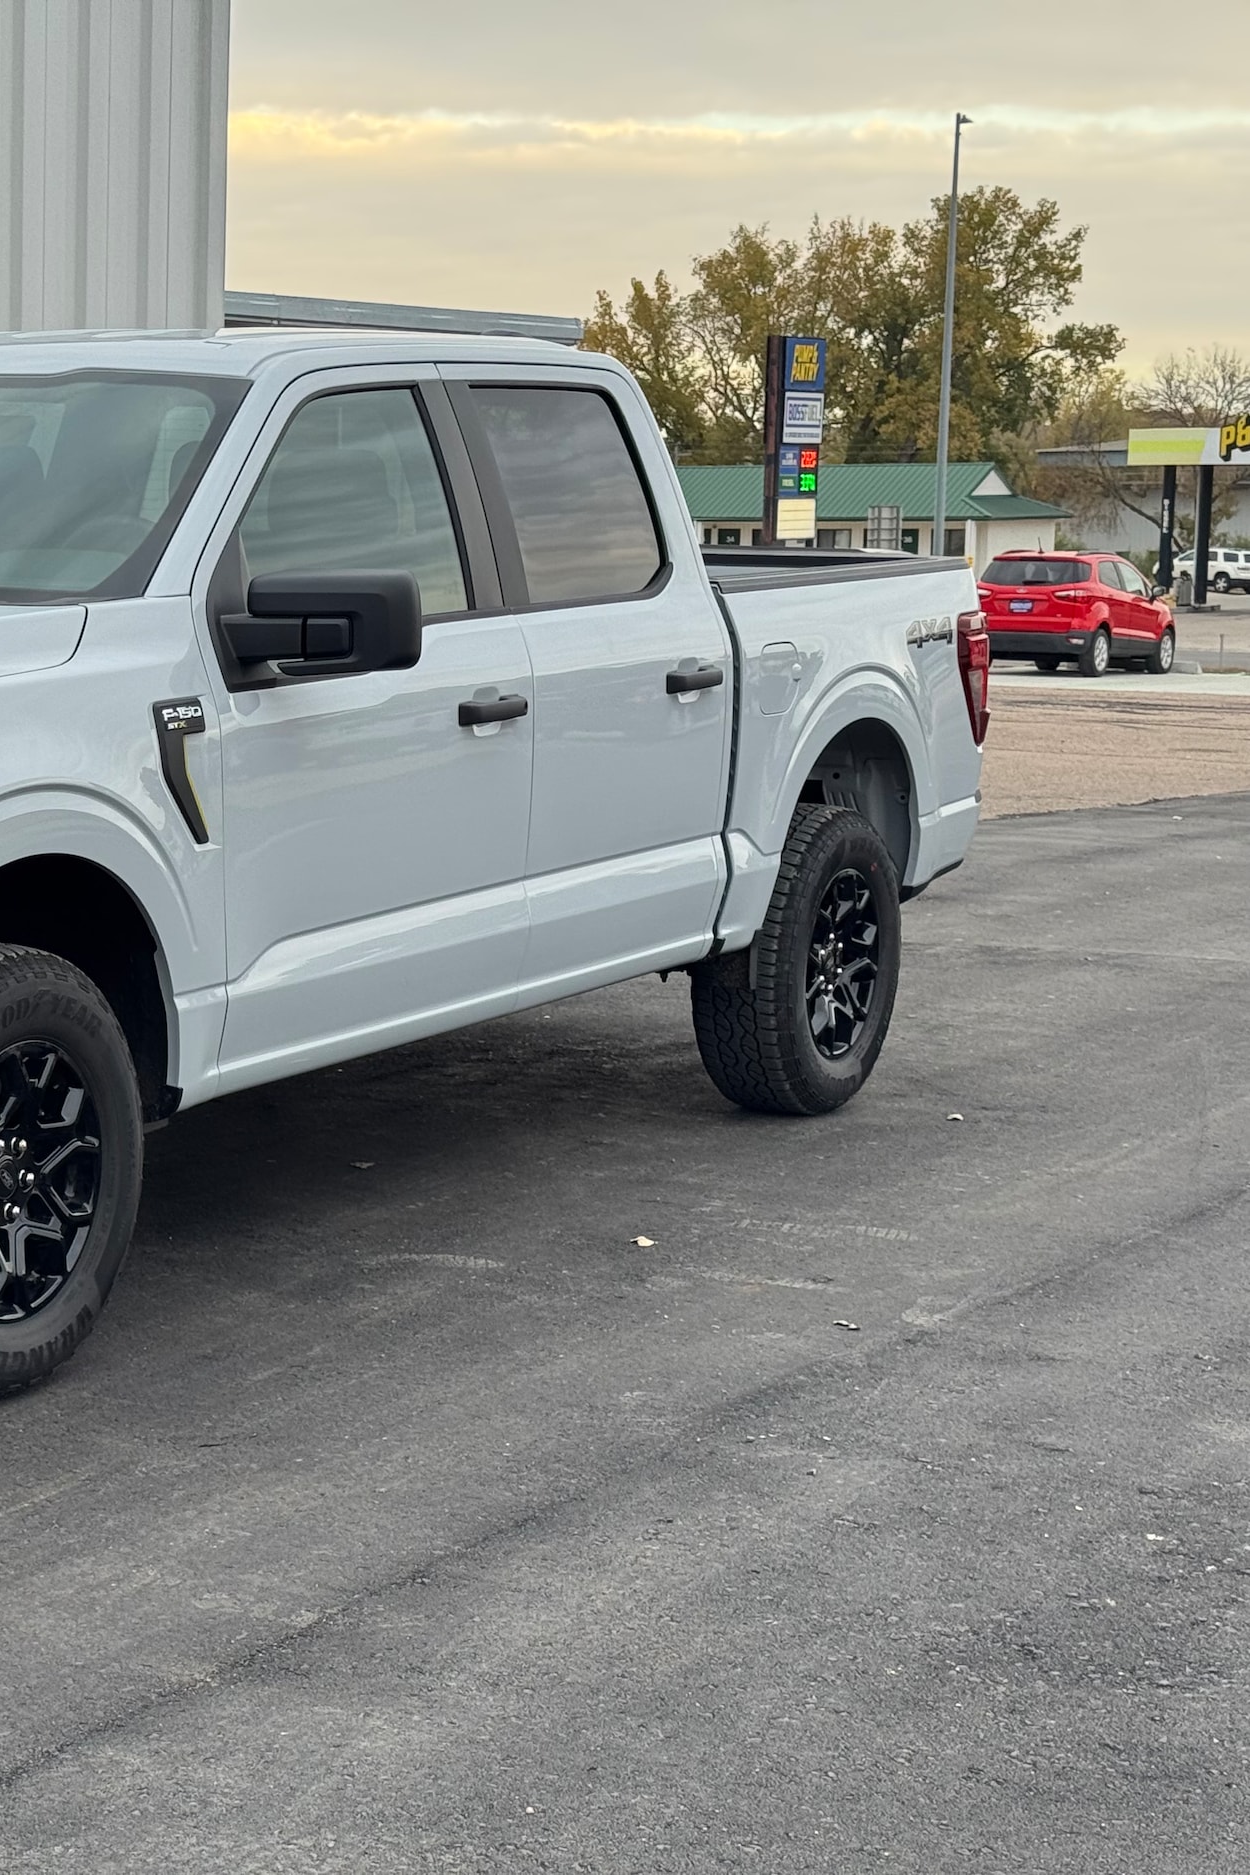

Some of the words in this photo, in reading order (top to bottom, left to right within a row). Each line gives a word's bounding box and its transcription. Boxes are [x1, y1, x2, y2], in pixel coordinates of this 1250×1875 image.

[791, 363, 819, 382] PANTRY
[162, 706, 203, 721] F-150
[167, 720, 188, 730] STX
